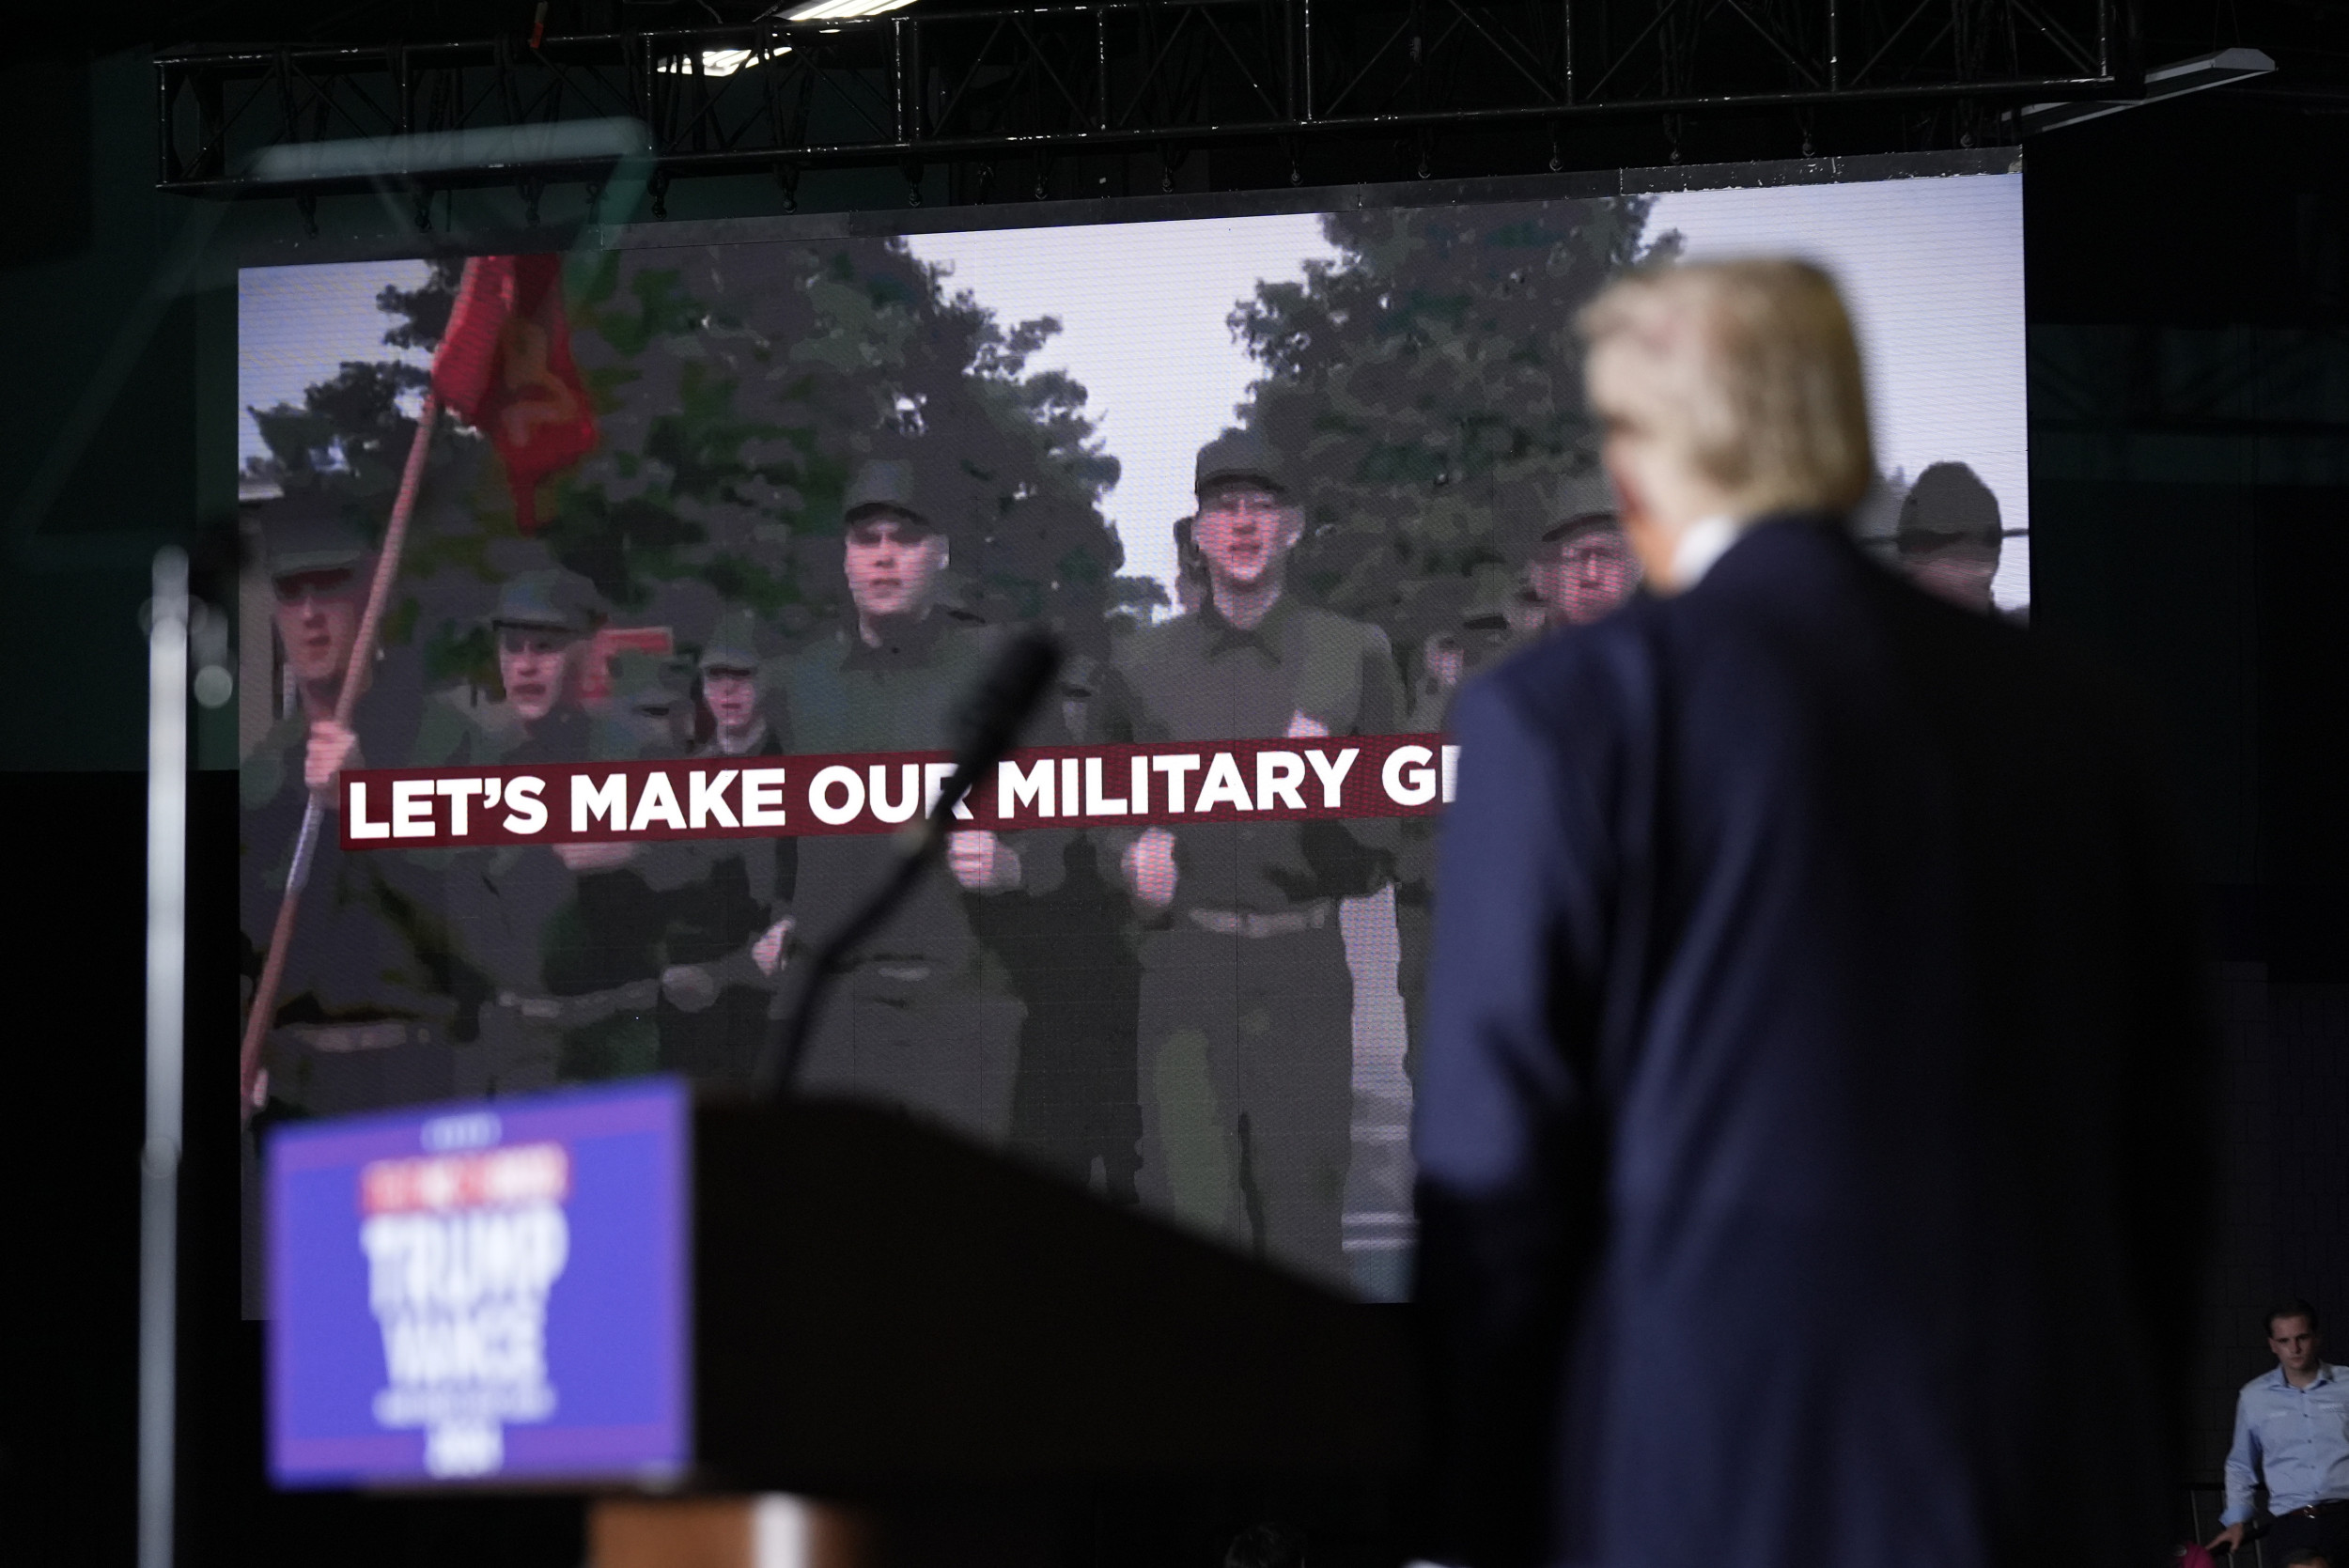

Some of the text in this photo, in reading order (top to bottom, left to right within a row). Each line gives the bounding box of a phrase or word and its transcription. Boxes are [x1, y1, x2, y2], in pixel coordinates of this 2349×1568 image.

[349, 774, 549, 839] LET’S
[570, 766, 786, 833] MAKE
[808, 763, 974, 825] OUR
[998, 748, 1360, 819] MILITARY
[360, 1205, 569, 1313] TRUMP
